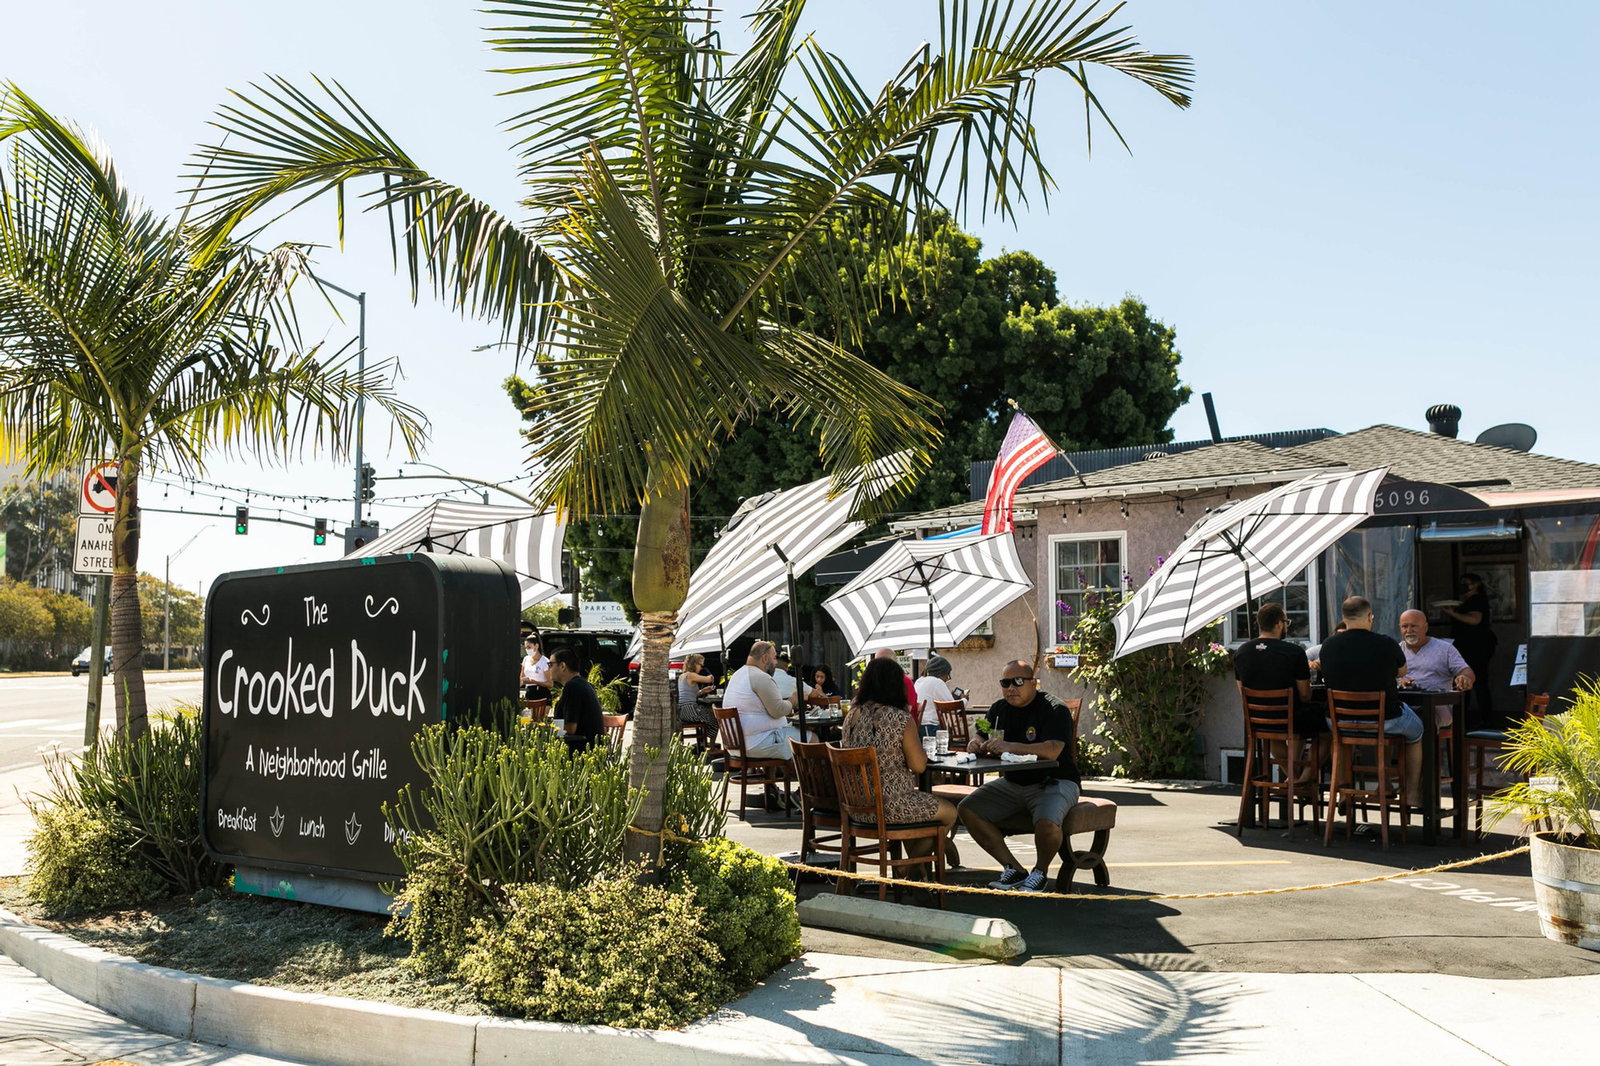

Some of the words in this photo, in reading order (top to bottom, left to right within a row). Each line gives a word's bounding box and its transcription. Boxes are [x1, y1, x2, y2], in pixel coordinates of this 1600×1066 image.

[1375, 490, 1430, 508] 5096
[98, 523, 112, 534] ON
[81, 540, 113, 551] ANAHE
[83, 556, 113, 568] STREE
[304, 596, 328, 626] The
[217, 637, 335, 720] Crooked
[351, 630, 427, 721] Duck
[246, 744, 254, 772] A
[259, 746, 346, 780] Neighborhood
[352, 748, 387, 780] Grille
[218, 806, 256, 832] Breakfast
[299, 816, 325, 838] Lunch
[384, 821, 412, 845] Dine
[1388, 878, 1539, 912] MPACT
